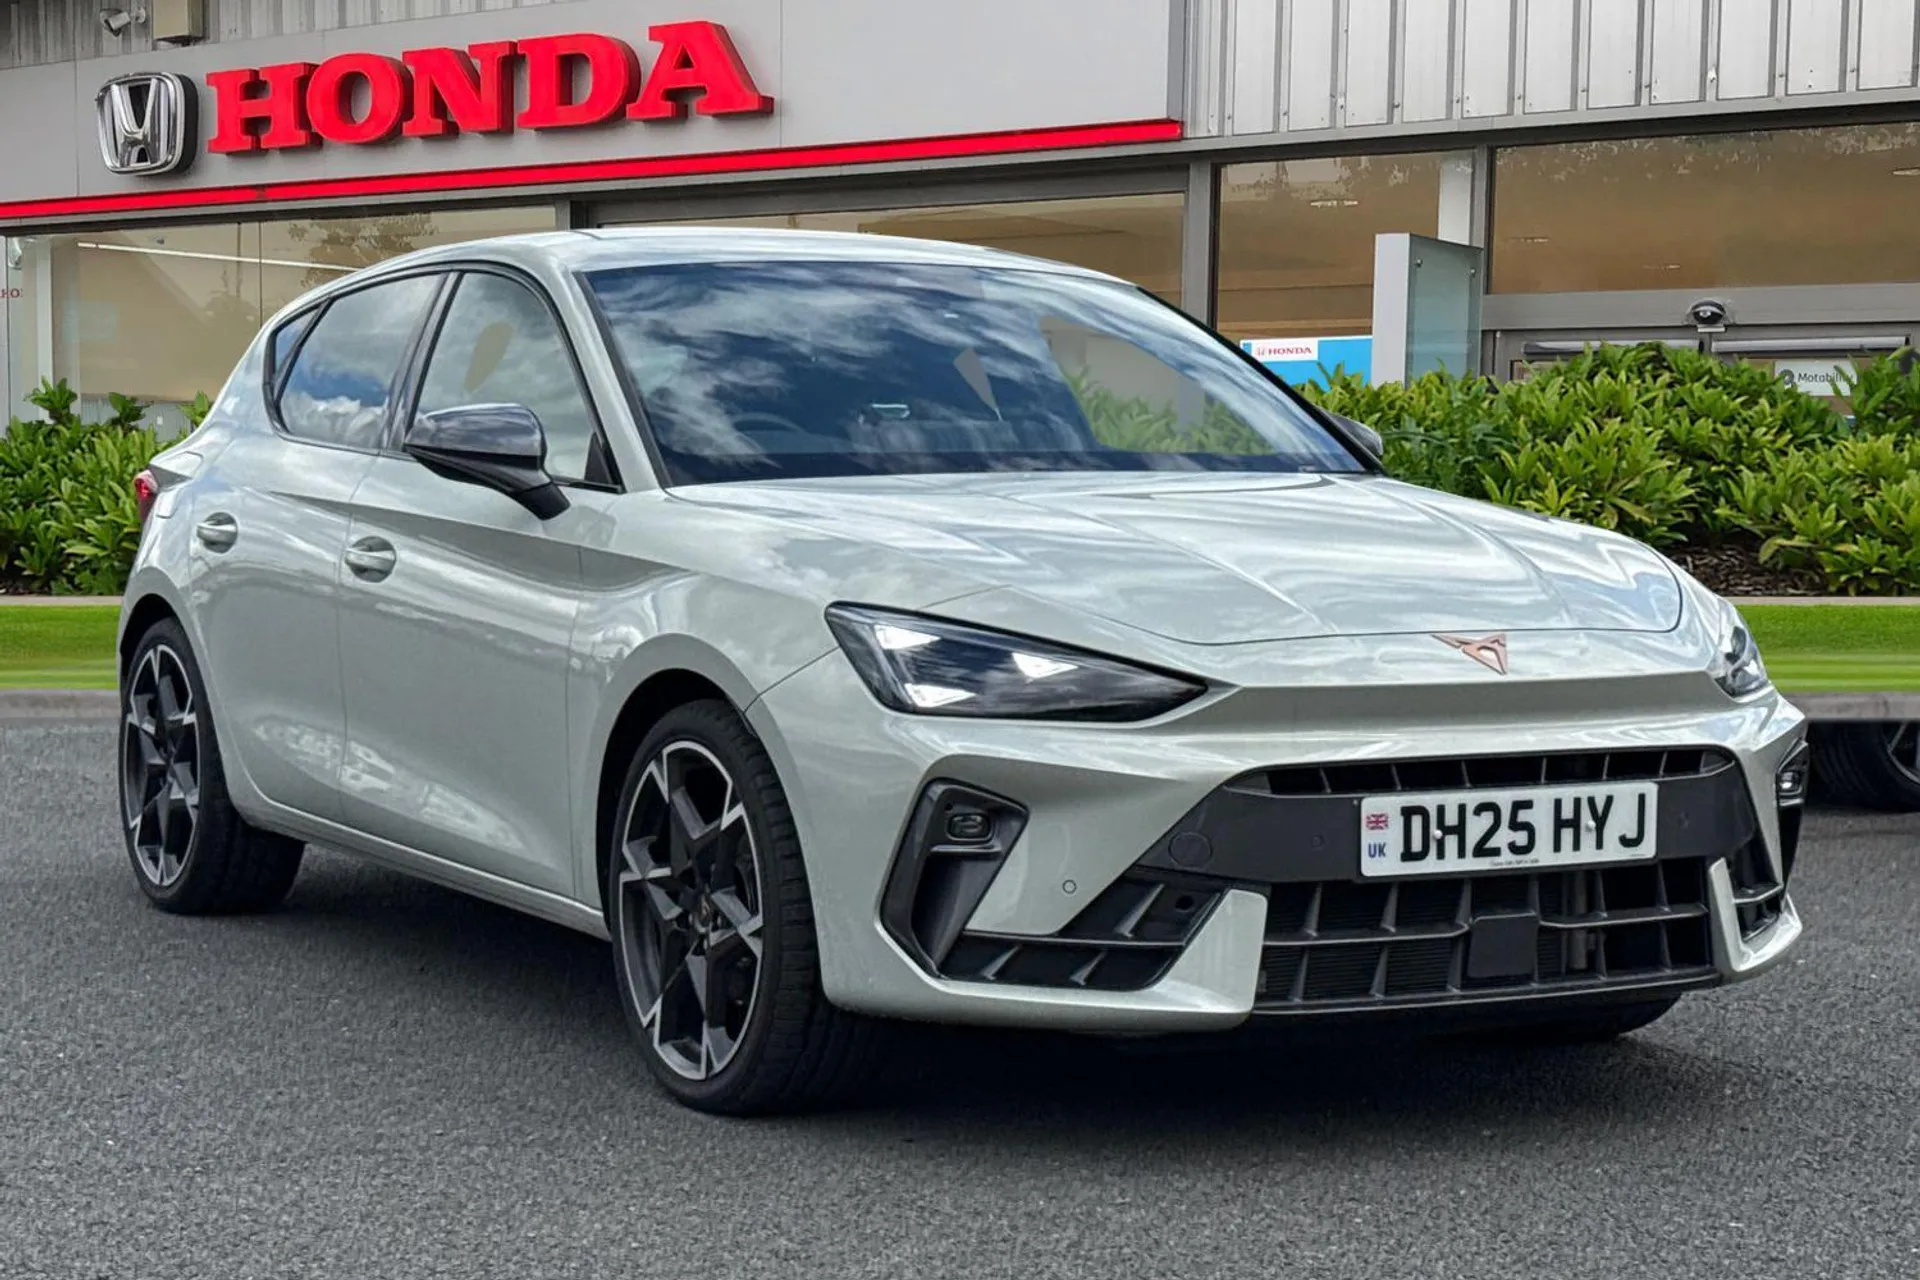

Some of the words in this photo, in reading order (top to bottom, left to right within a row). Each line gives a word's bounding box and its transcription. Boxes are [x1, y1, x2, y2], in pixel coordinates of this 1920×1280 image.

[206, 20, 775, 154] HONDA
[1268, 347, 1312, 356] HONDA
[1400, 800, 1537, 863] DH25
[1553, 793, 1646, 853] HYJ
[1367, 843, 1387, 858] UK
